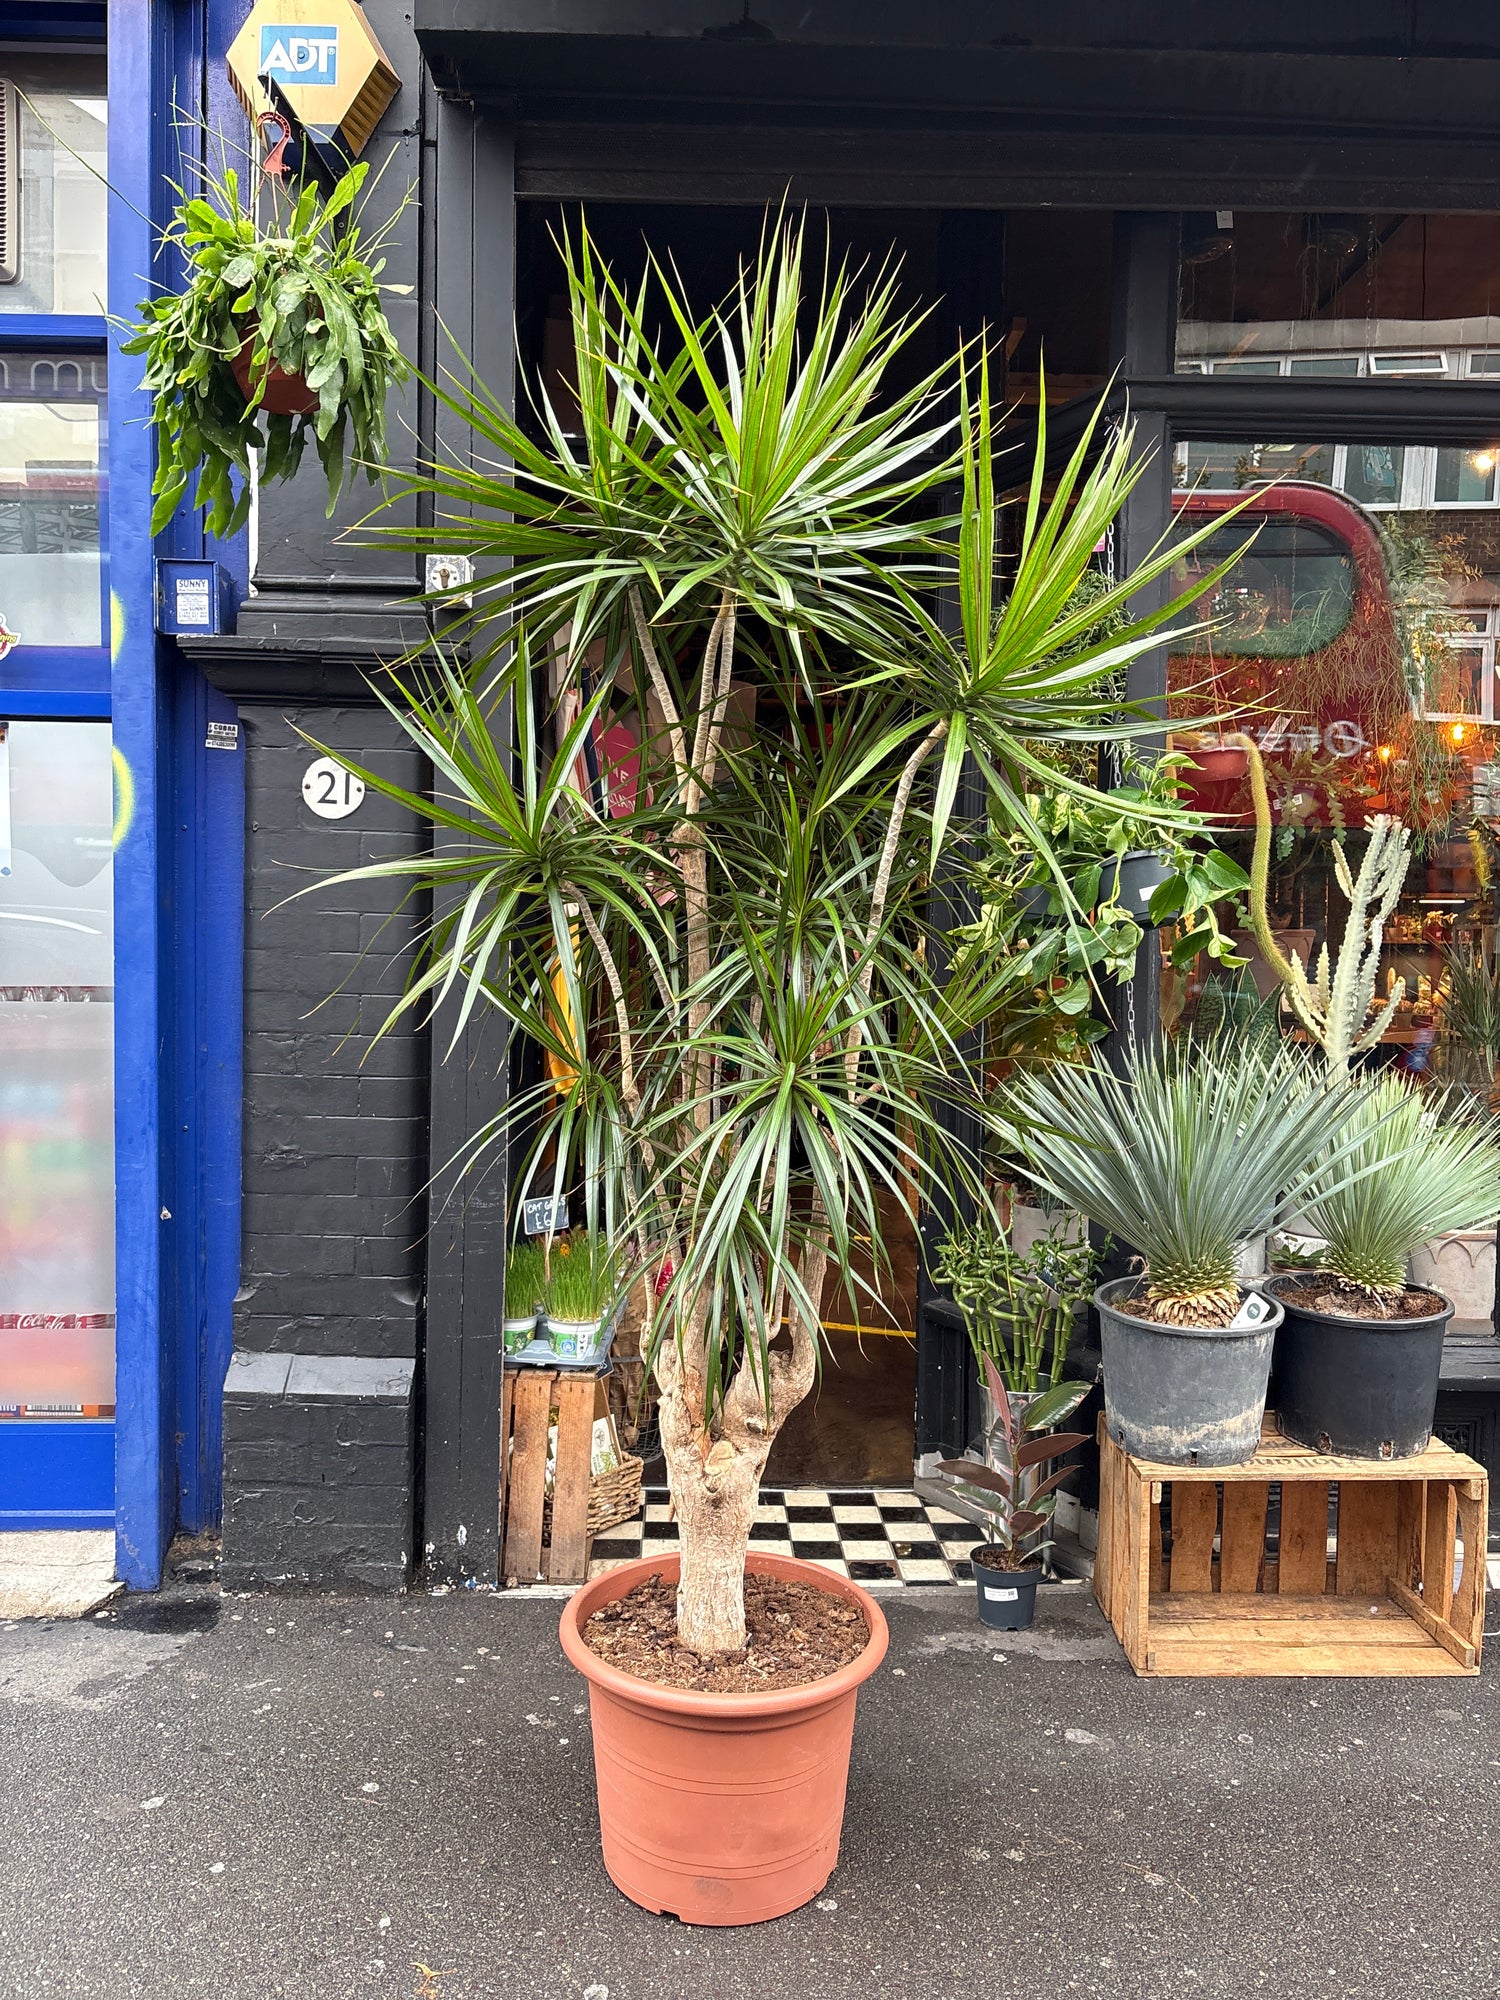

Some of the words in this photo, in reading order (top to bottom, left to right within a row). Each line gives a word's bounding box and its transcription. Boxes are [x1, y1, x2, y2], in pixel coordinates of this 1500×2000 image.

[261, 37, 337, 73] ADT
[178, 580, 206, 588] SUNNY
[213, 724, 236, 732] COBRA
[317, 771, 350, 805] 21
[527, 1202, 543, 1213] CAT
[535, 1211, 552, 1229] £6
